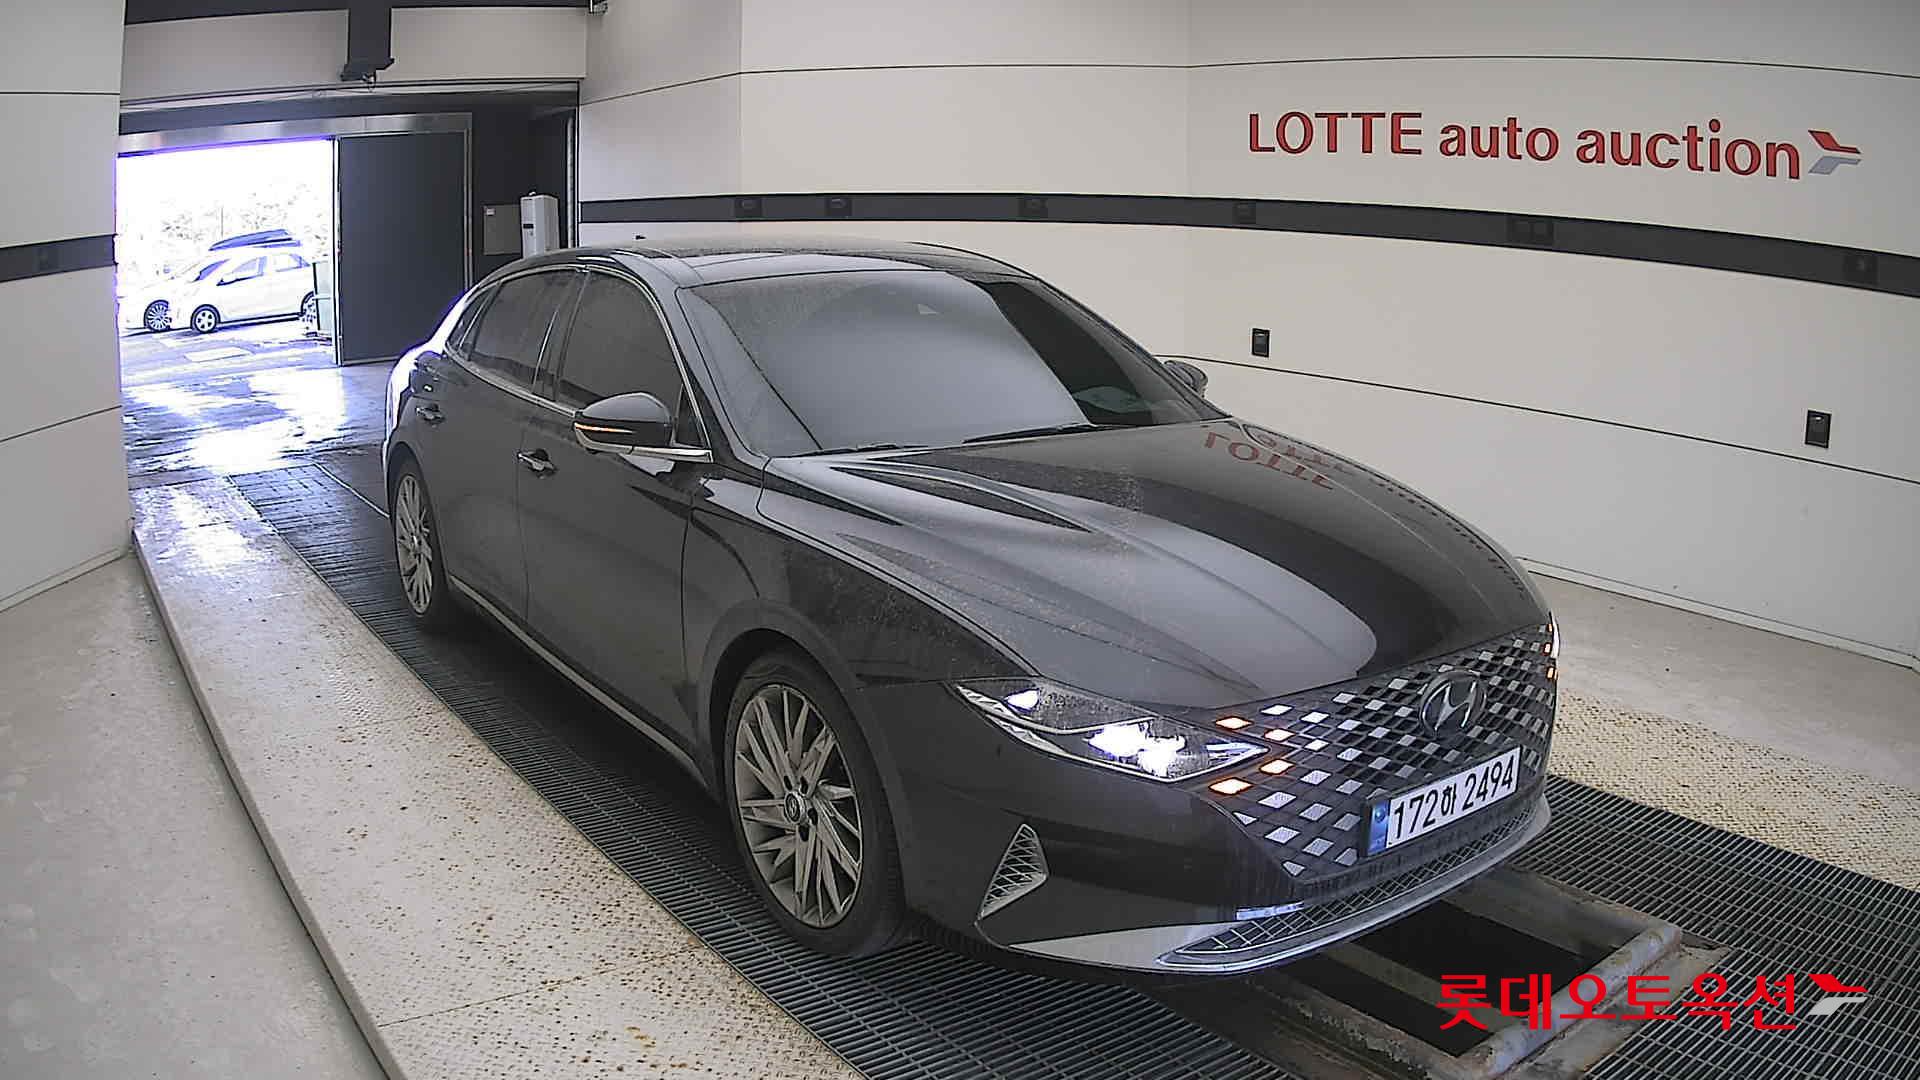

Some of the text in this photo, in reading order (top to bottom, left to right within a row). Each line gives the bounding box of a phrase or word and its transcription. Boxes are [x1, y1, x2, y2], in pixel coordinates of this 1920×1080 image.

[1249, 111, 1802, 180] LOTTE auto auction
[1394, 754, 1515, 840] 172하 2494
